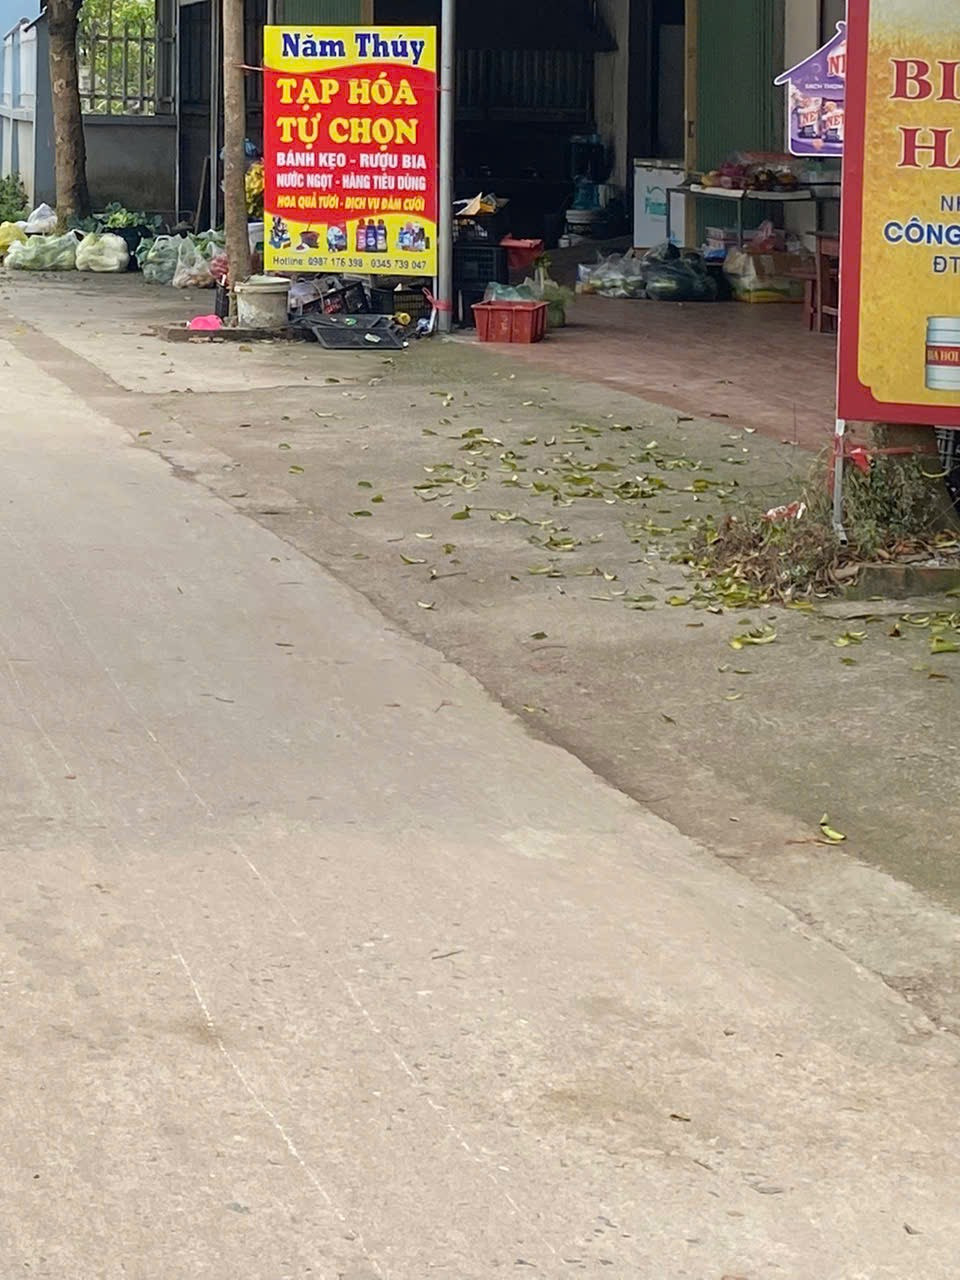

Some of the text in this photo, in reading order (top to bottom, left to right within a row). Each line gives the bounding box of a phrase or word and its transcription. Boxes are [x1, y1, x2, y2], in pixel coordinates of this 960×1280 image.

[282, 33, 425, 65] Năm Thúy
[276, 71, 418, 111] TẠP HÓA
[888, 58, 960, 103] BI
[276, 112, 419, 151] TỰ CHỌN
[276, 149, 315, 167] BÁNH
[318, 152, 346, 170] KẸO
[359, 152, 399, 172] RƯỢU
[402, 154, 427, 169] BIA
[897, 126, 960, 170] H
[276, 170, 304, 188] NƯỚC
[306, 173, 333, 191] NGỌT
[342, 171, 371, 189] HÀNG
[372, 172, 395, 190] TIÊU
[397, 173, 427, 191] DÙNG
[277, 195, 297, 209] HOA
[298, 192, 317, 209] QUẢ
[345, 196, 367, 213] DỊCH
[368, 197, 380, 213] VỤ
[883, 217, 960, 246] CÔNG
